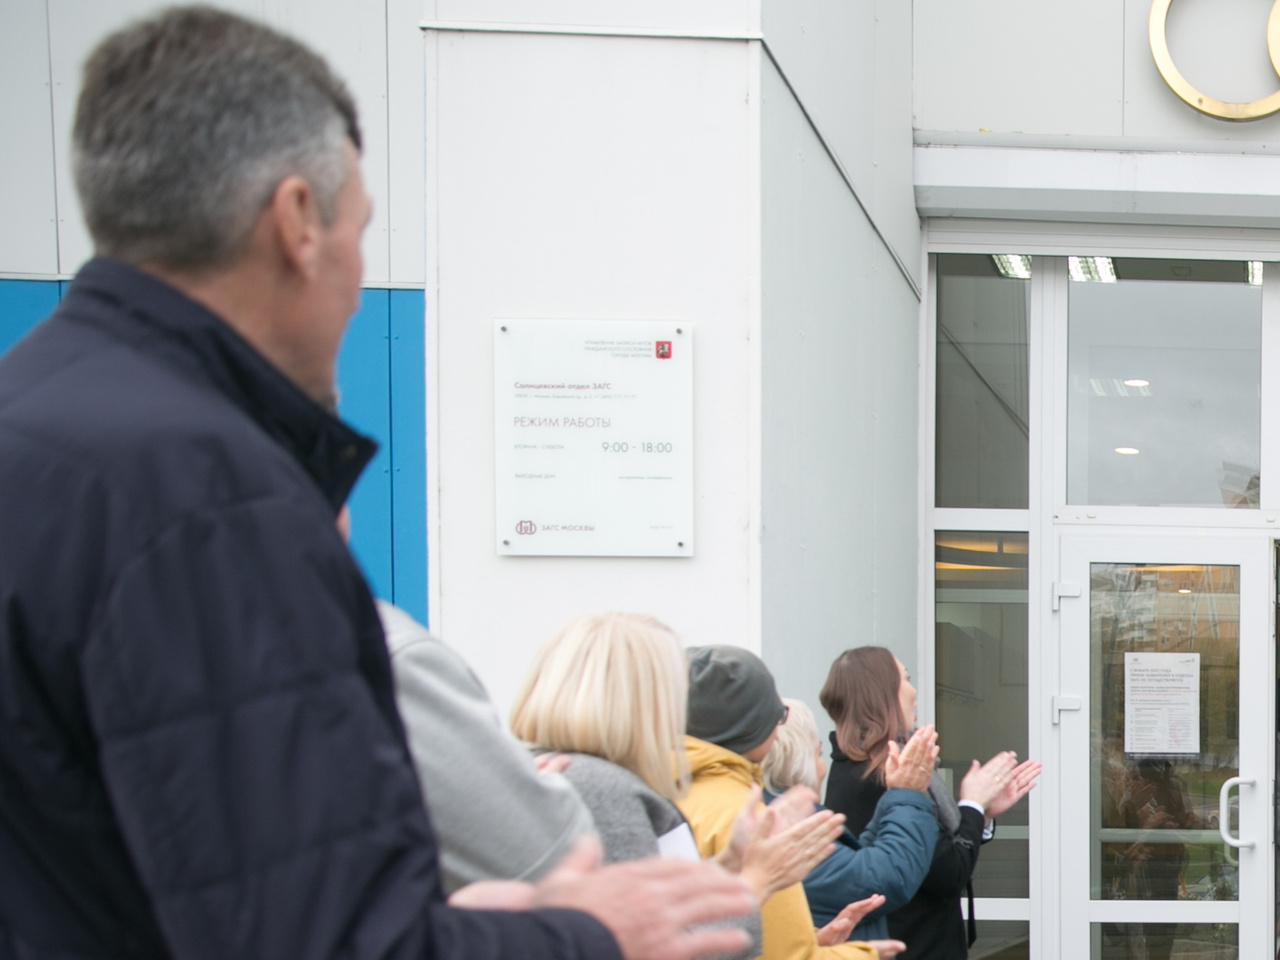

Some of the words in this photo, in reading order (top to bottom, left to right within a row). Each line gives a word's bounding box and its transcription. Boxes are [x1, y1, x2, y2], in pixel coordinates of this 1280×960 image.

[514, 381, 566, 391] Солнцевский
[567, 383, 590, 391] отдел
[592, 382, 612, 390] ЗАГС
[513, 416, 560, 428] РЕЖИМ
[563, 416, 611, 428] РАБОТЫ
[601, 441, 629, 453] 9:00
[641, 441, 673, 454] 18:00
[541, 524, 560, 532] ЗАГС
[561, 524, 595, 532] МОСКВЫ
